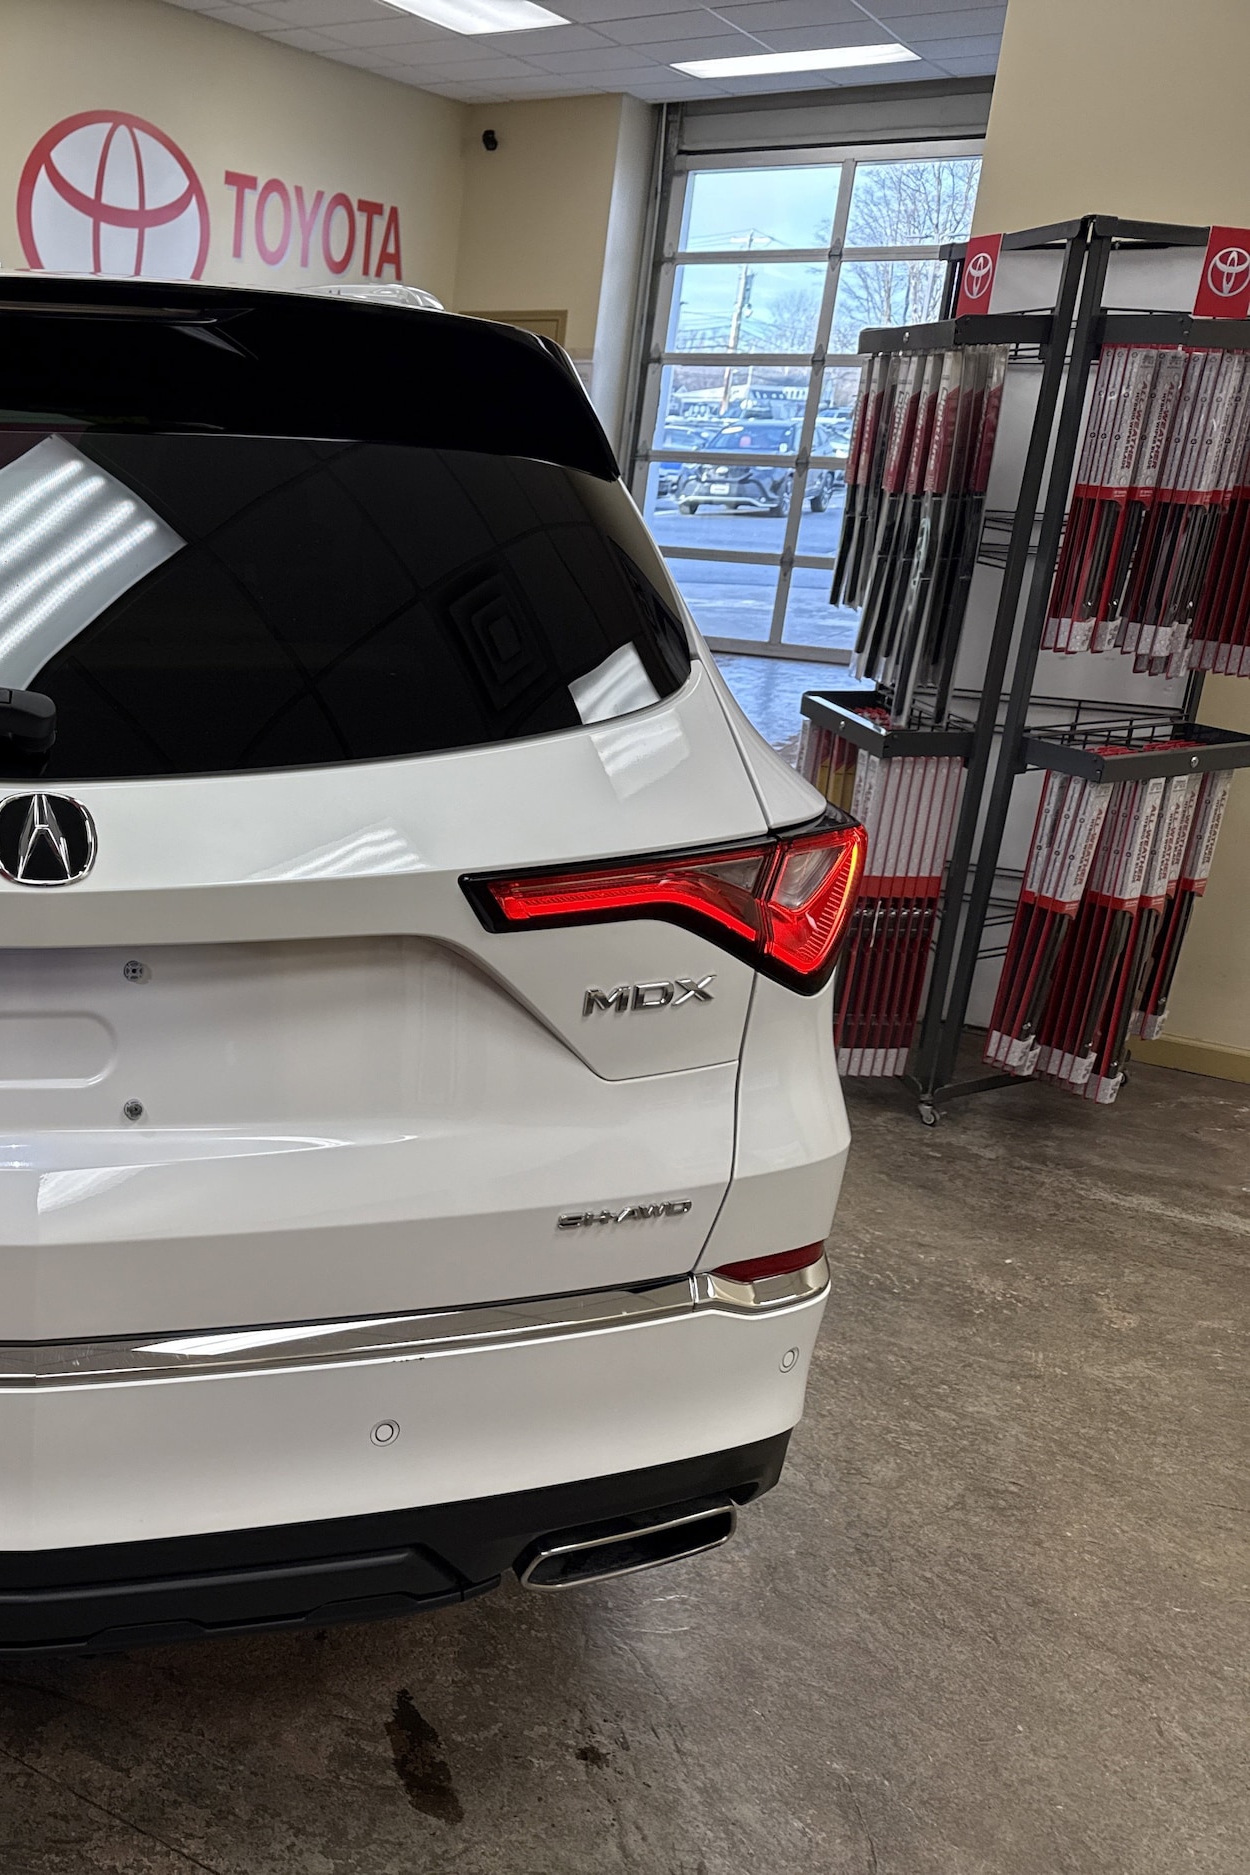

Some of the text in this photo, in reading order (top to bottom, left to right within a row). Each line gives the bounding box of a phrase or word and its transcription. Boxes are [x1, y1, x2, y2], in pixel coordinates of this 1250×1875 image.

[224, 170, 402, 282] TOYOTA
[1120, 445, 1129, 469] BLADE
[1125, 380, 1148, 469] ALL-WEATHER
[1125, 421, 1134, 443] WIPER
[1146, 446, 1155, 469] BLADE
[1151, 381, 1175, 469] ALL-WEATHER
[1152, 421, 1160, 443] WIPER
[1077, 808, 1103, 884] ALL-WEATHER
[1135, 804, 1156, 881] ALL-WEATHER
[1161, 802, 1180, 879] ALL-WEATHER
[1205, 790, 1227, 862] ALL-WEATHER
[583, 974, 717, 1016] MDX
[558, 1199, 693, 1230] SH-AWD
